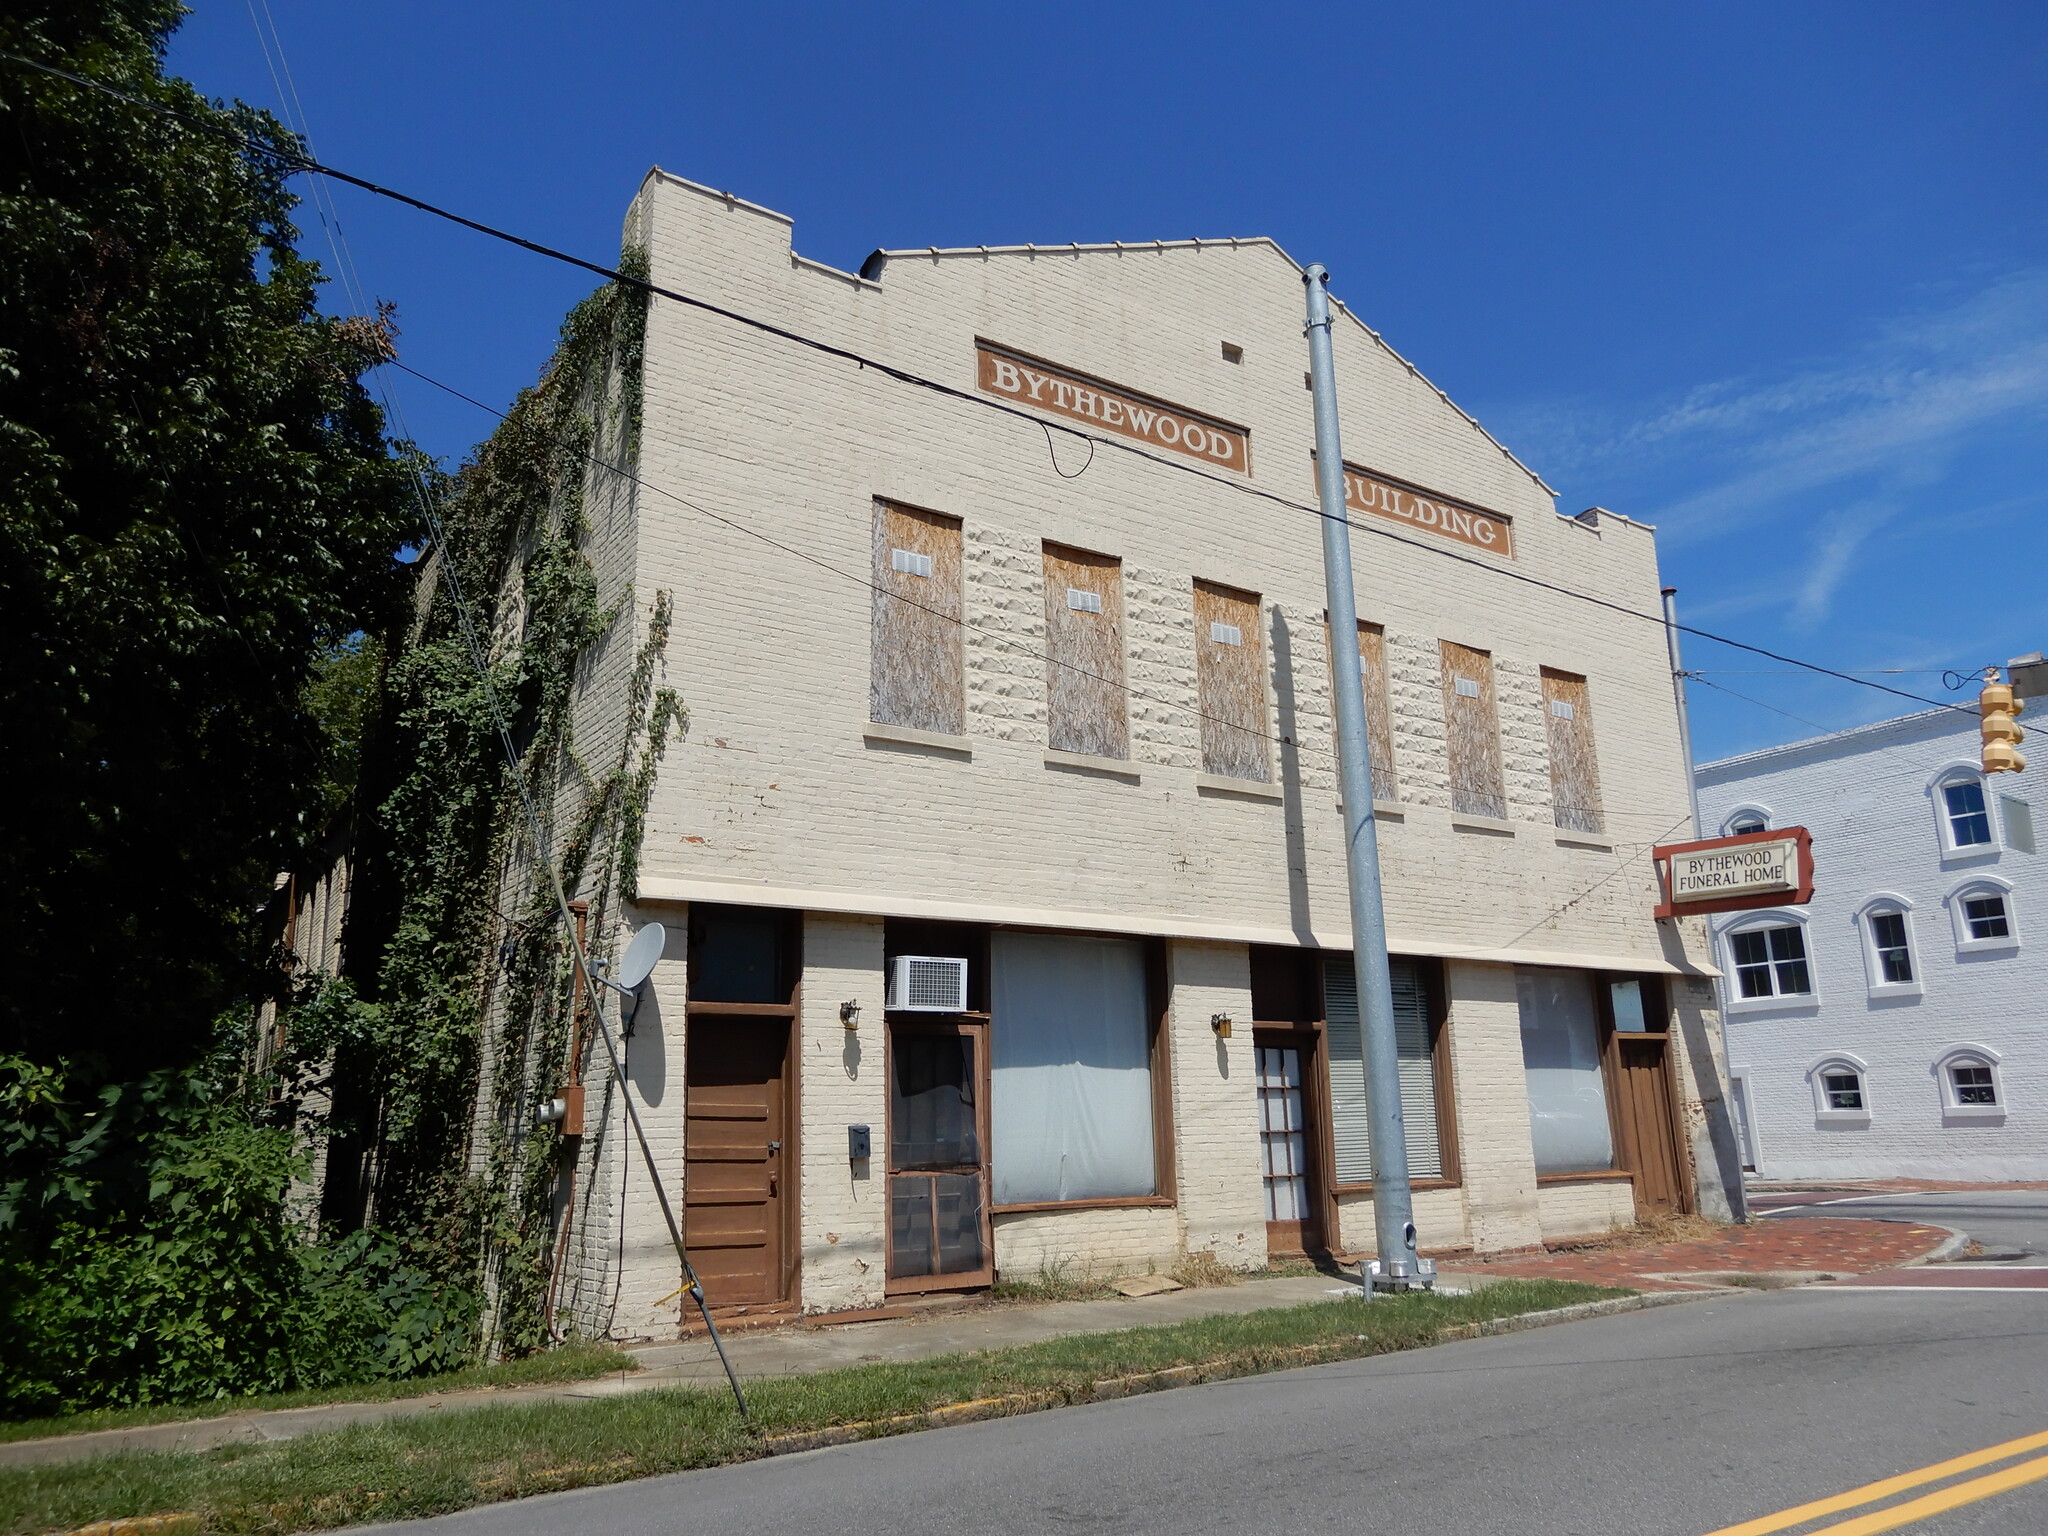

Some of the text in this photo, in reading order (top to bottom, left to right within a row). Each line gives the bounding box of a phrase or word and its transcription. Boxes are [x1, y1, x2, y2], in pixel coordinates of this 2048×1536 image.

[992, 359, 1233, 459] BYTHEWOOD
[1689, 851, 1772, 874] BYTHEWOOD
[1680, 865, 1783, 890] FUNERAL HOME
